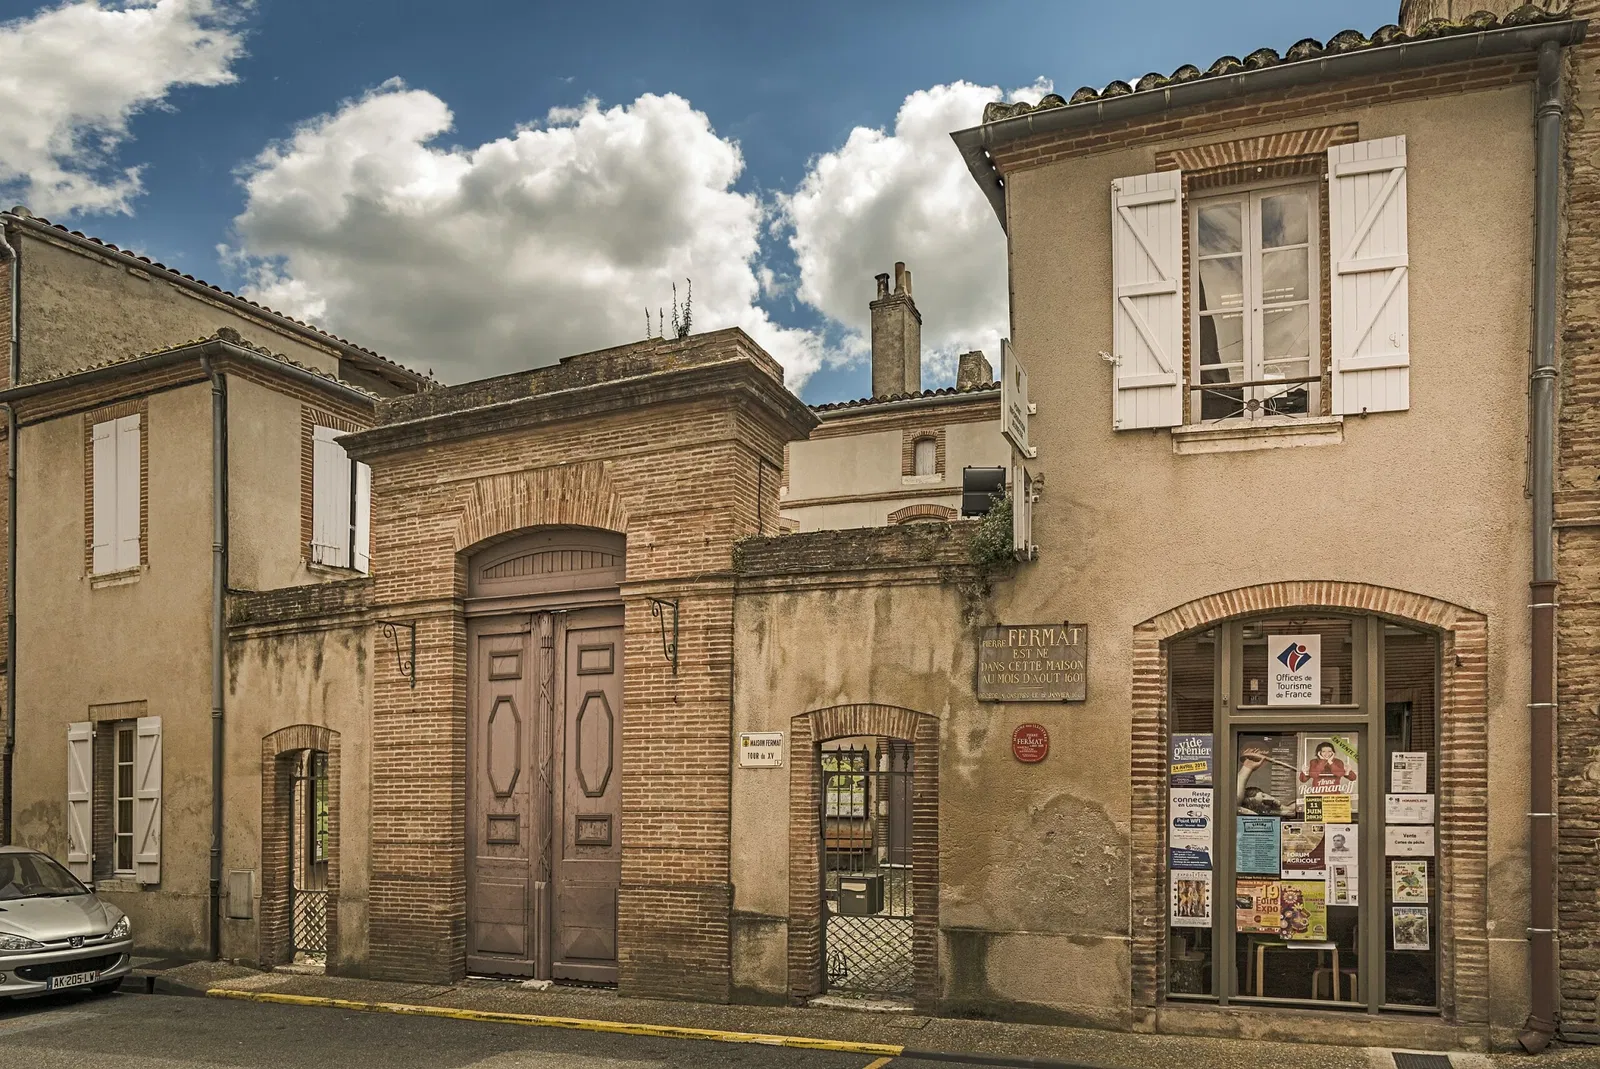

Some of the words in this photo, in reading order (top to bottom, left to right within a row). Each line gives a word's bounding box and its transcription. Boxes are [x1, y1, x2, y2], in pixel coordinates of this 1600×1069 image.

[982, 639, 1006, 649] PIERRE
[1008, 628, 1083, 647] FERMAT
[1013, 649, 1032, 659] EST
[981, 661, 1005, 672] DANS
[1008, 660, 1042, 672] CETTE
[1046, 660, 1084, 671] MAISON
[982, 674, 995, 684] AU
[997, 673, 1020, 684] MOIS
[1179, 737, 1203, 750] vide
[1332, 736, 1340, 744] EN
[1340, 743, 1355, 755] VENTE
[1174, 747, 1212, 760] grenier
[1299, 781, 1356, 794] Roumanoff
[1256, 896, 1279, 905] Foire
[1256, 904, 1279, 914] Expo
